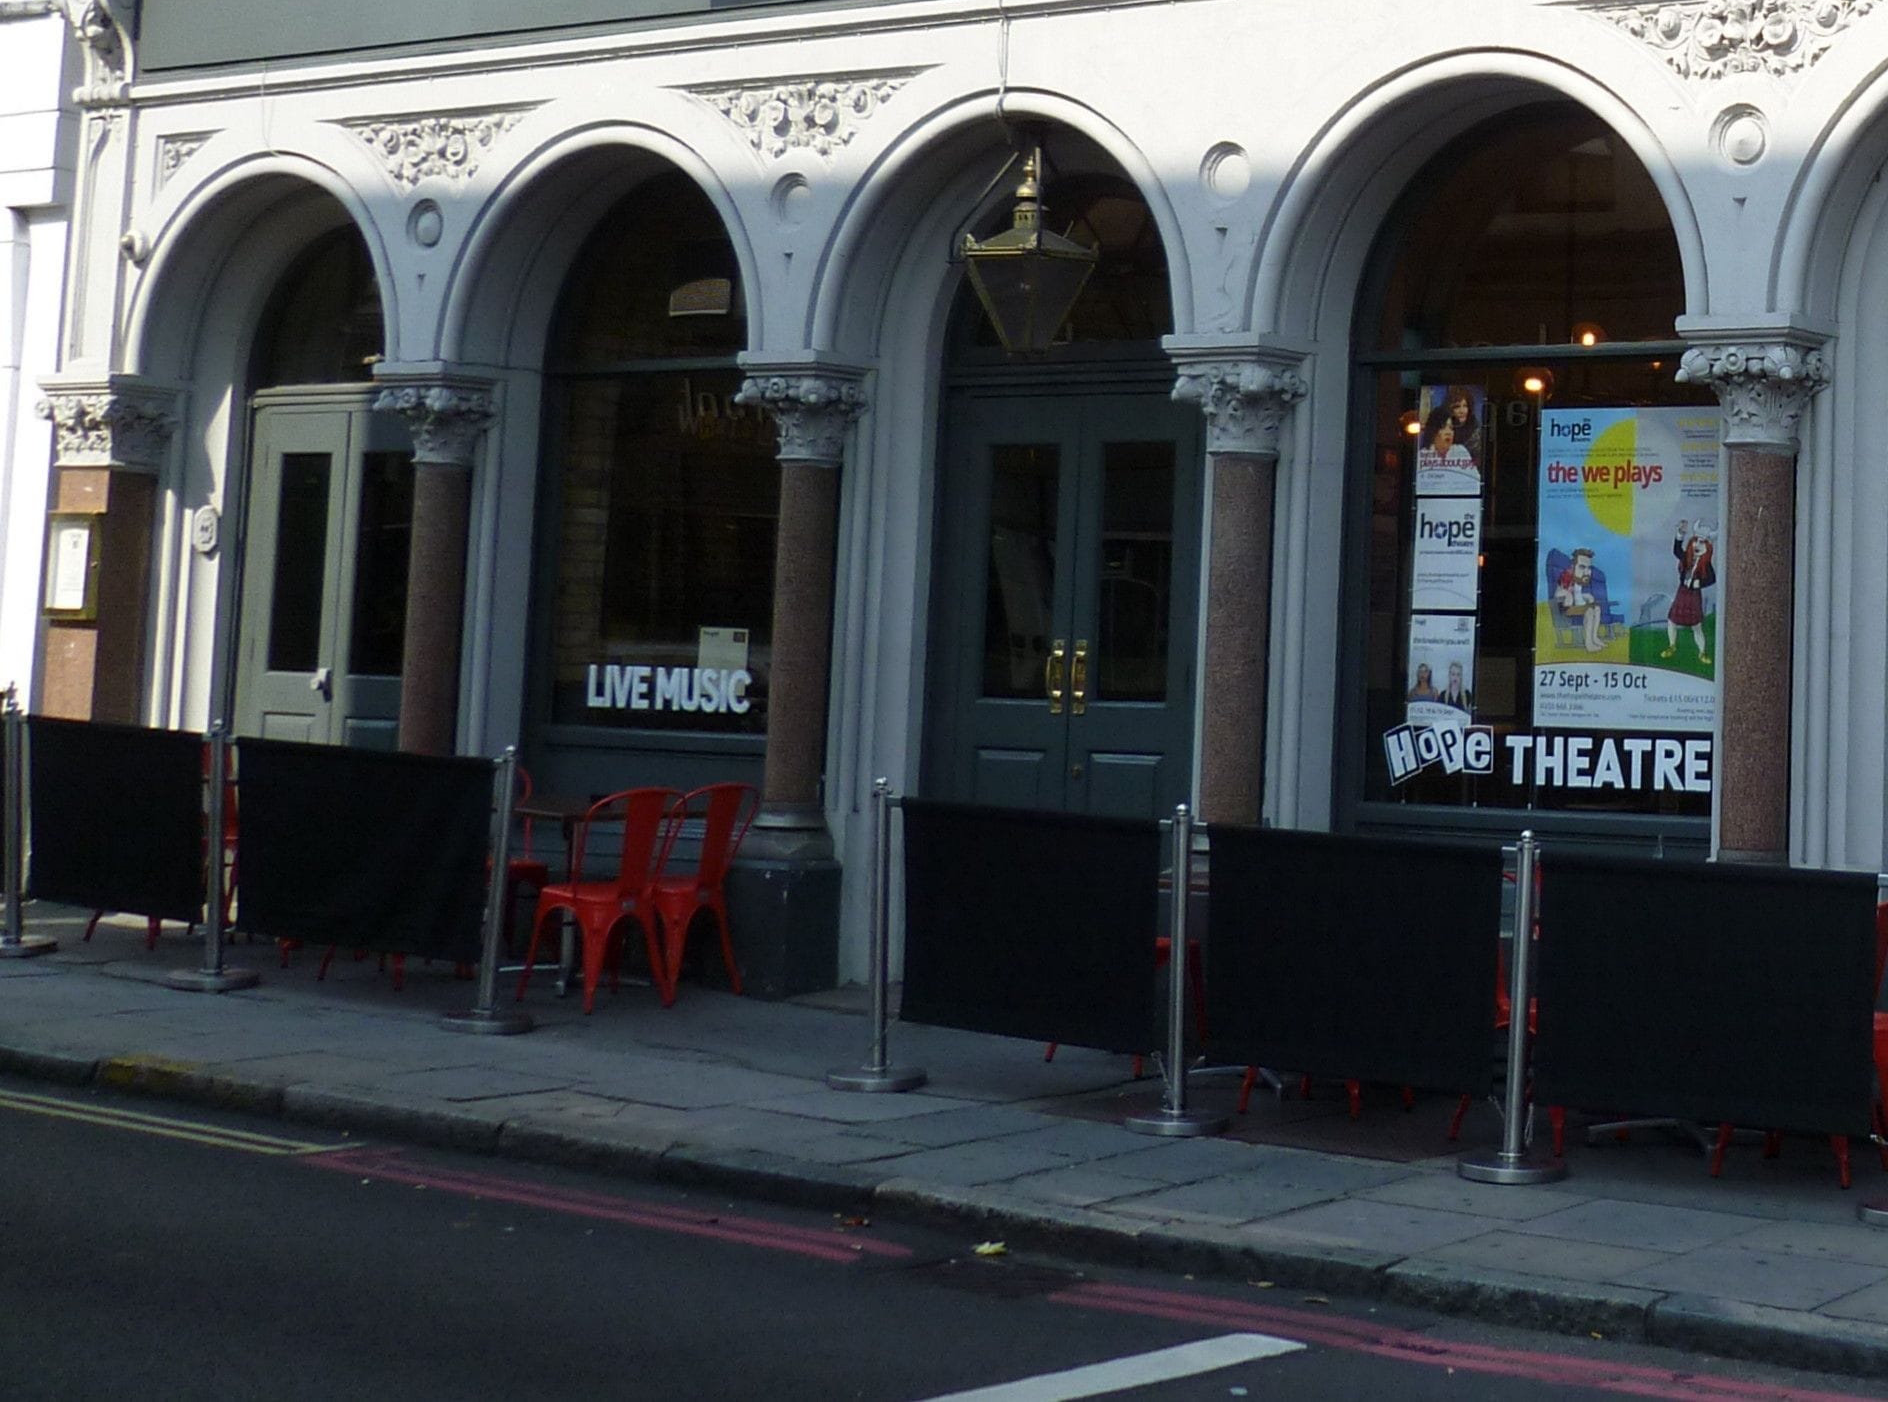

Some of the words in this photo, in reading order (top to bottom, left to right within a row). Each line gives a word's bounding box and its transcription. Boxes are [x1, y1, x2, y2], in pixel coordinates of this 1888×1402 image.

[1550, 418, 1591, 442] hope
[1547, 461, 1578, 484] the
[1581, 465, 1611, 484] we
[1613, 459, 1663, 489] plays
[1420, 513, 1475, 547] hope
[587, 664, 651, 710] LIVE
[655, 666, 752, 715] MUSIC
[1540, 671, 1555, 687] 27
[1559, 671, 1590, 692] Sept
[1603, 672, 1618, 688] 15
[1623, 672, 1647, 689] Oct
[1506, 735, 1712, 793] THEATRE
